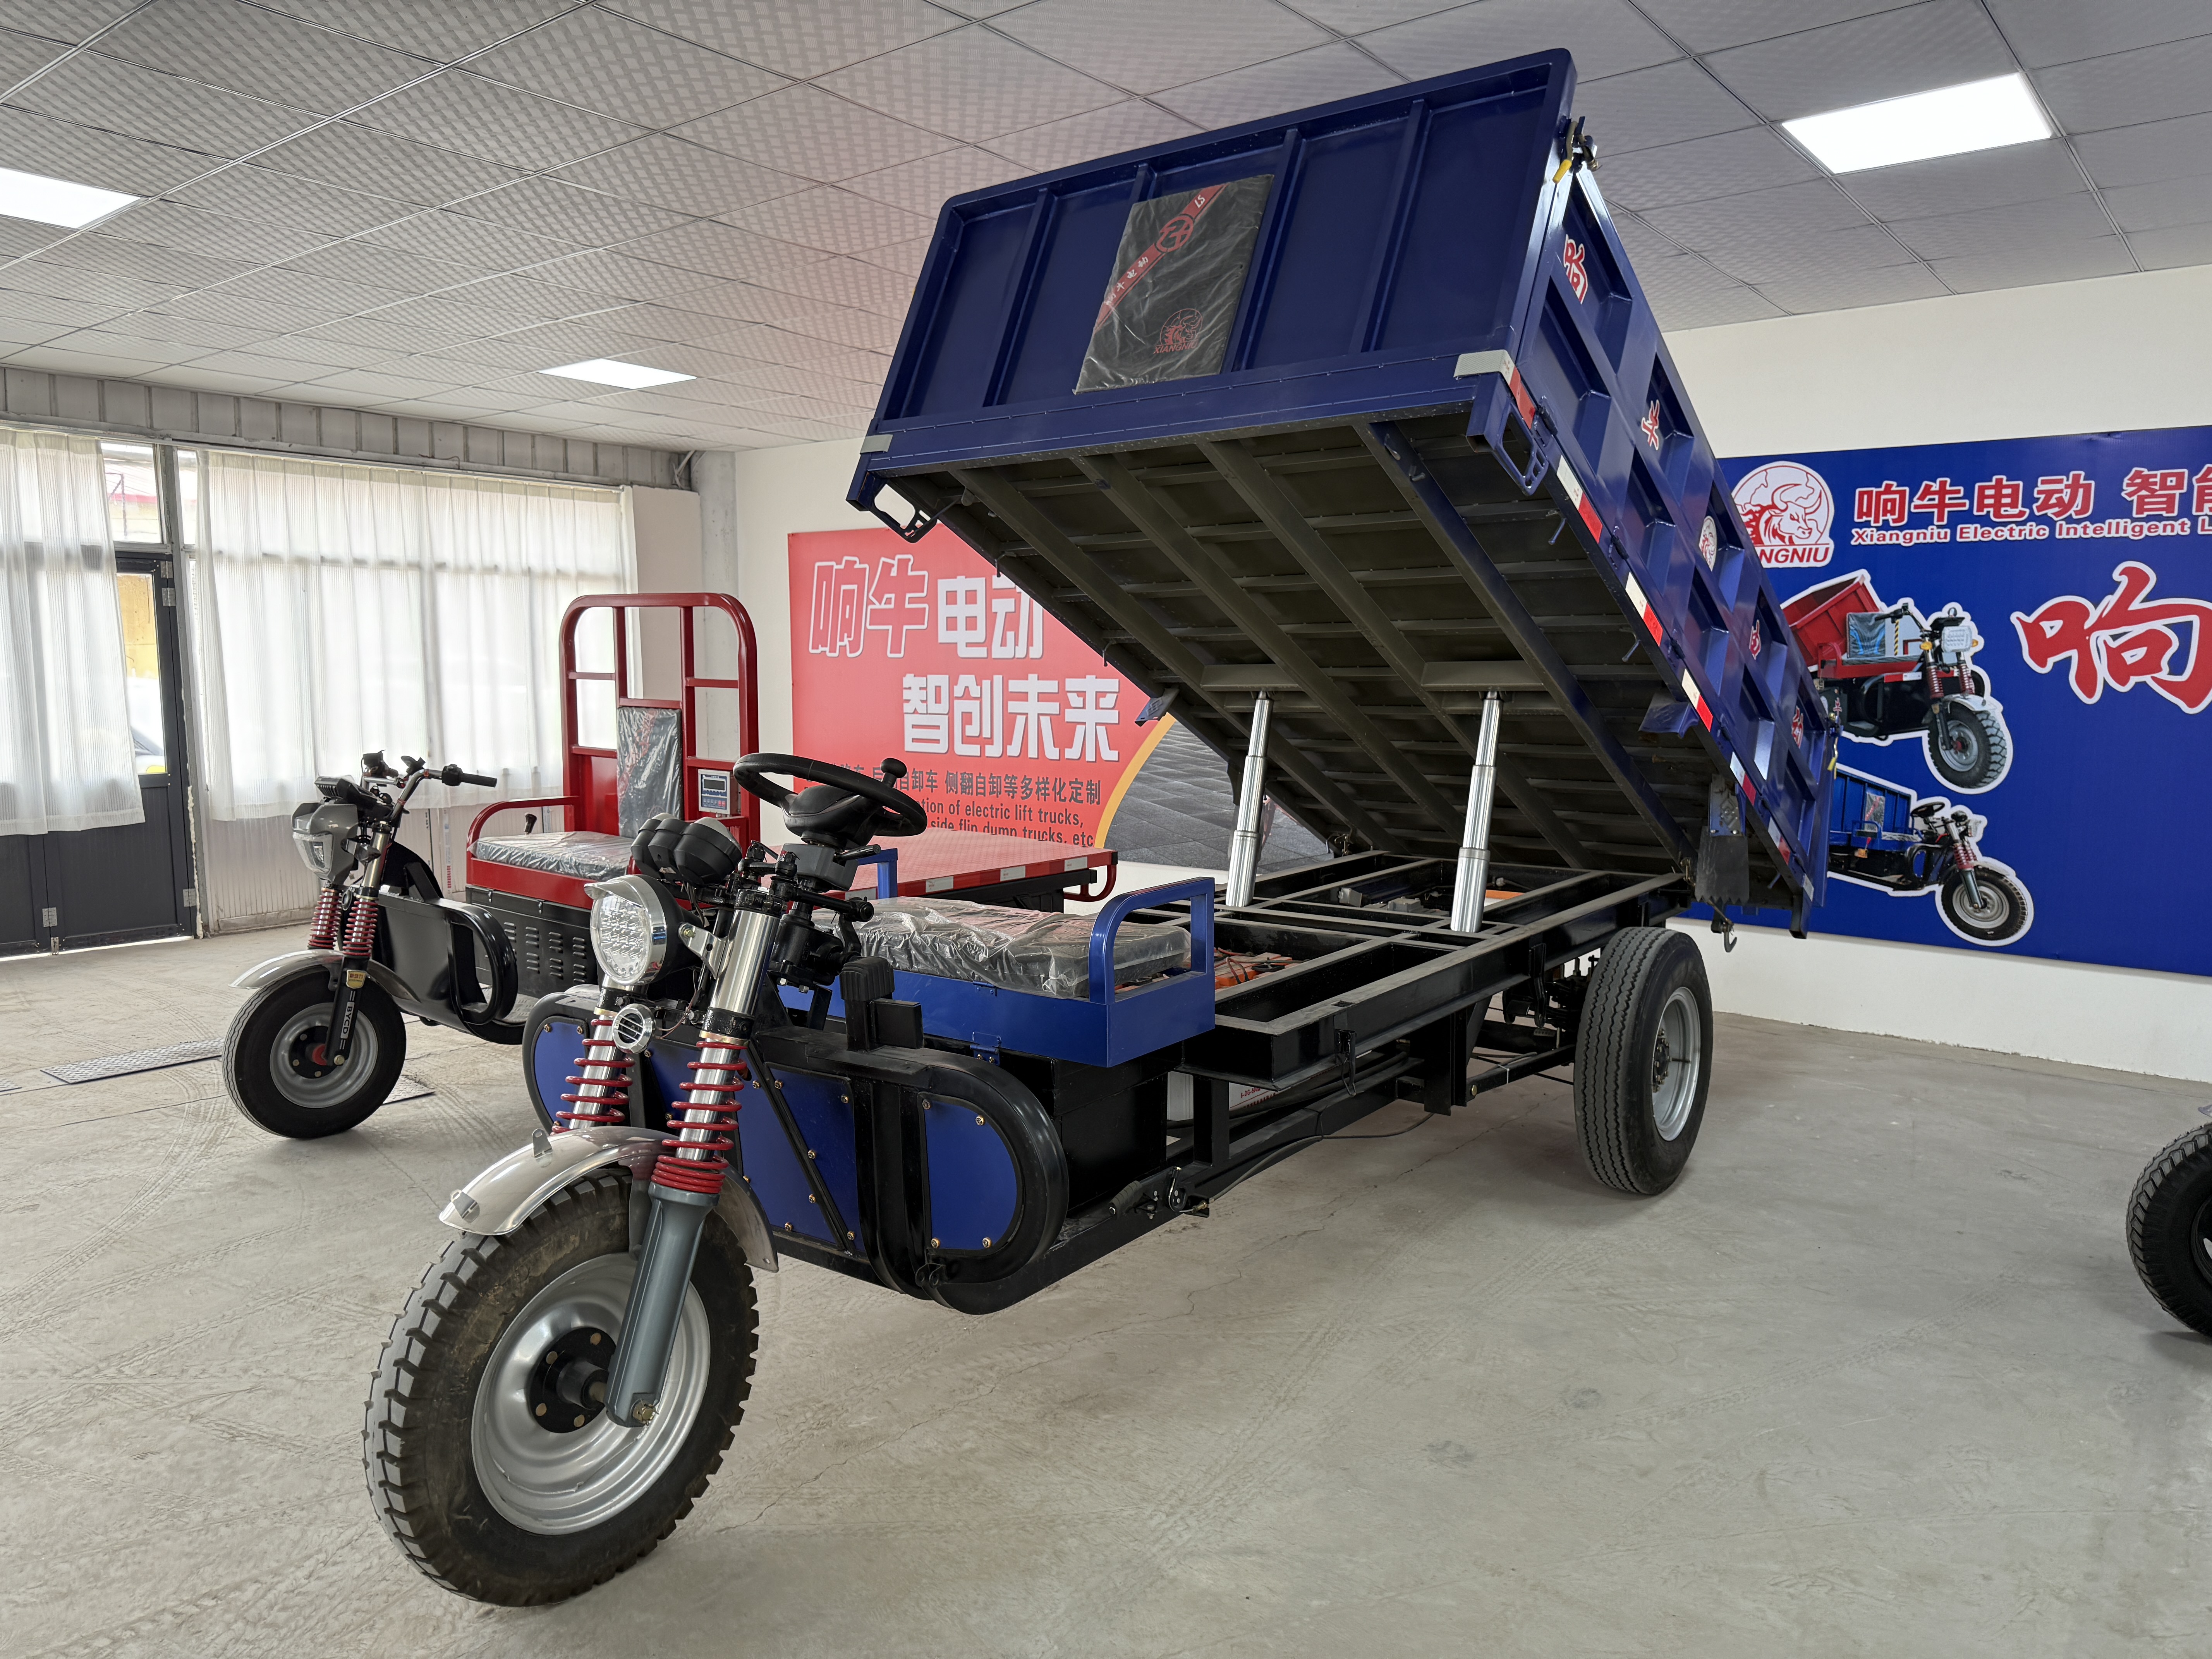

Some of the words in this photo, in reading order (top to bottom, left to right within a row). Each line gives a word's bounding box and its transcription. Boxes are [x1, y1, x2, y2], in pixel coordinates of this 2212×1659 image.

[1153, 339, 1199, 354] XIANGNIU
[1856, 472, 2093, 525] 响牛电动
[1853, 529, 1949, 544] Xiangniu
[1958, 523, 2047, 539] Electric
[2057, 520, 2189, 538] Intelligent
[902, 673, 1120, 762] 智创未来
[945, 770, 1101, 805] 侧翻自卸等多样化定制
[949, 800, 960, 815] of
[965, 801, 1010, 819] electric
[1015, 805, 1033, 821] lift
[1039, 808, 1083, 828] trucks,
[343, 1006, 352, 1034] BYCD
